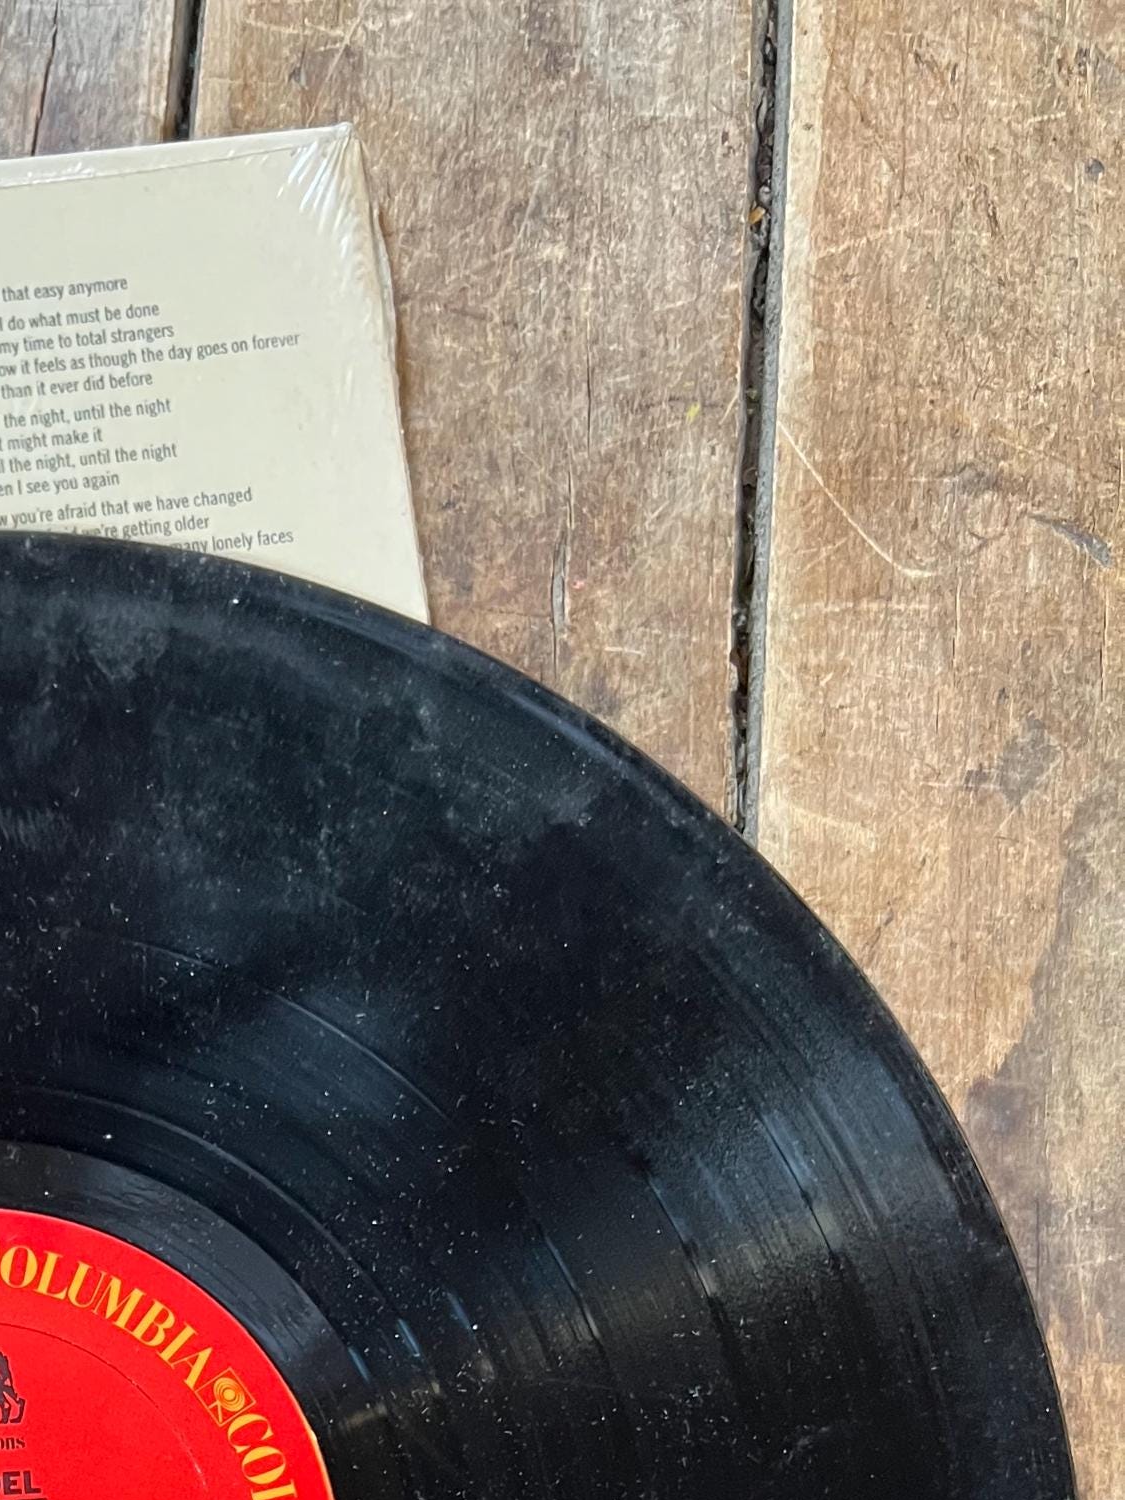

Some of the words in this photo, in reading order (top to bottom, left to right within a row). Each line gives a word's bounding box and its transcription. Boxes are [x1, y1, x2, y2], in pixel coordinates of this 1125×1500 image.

[2, 287, 29, 301] that
[34, 286, 64, 300] easy
[68, 278, 128, 297] anymore
[0, 317, 3, 331] I
[8, 316, 25, 331] do
[29, 312, 62, 328] what
[66, 309, 100, 325] must
[105, 306, 121, 321] be
[126, 304, 160, 319] done
[21, 361, 29, 375] it
[34, 357, 66, 373] feels
[70, 357, 85, 369] as
[89, 348, 137, 368] though
[141, 346, 164, 363] the
[168, 345, 192, 361] day
[197, 343, 228, 360] goes
[231, 340, 248, 354] on
[252, 334, 300, 350] forever
[4, 412, 26, 428] the
[30, 408, 70, 427] night,
[74, 405, 105, 423] until
[109, 402, 131, 419] the
[136, 398, 171, 417] night
[17, 480, 22, 494] I
[26, 477, 50, 492] see
[54, 476, 79, 494] you
[83, 471, 120, 491] again
